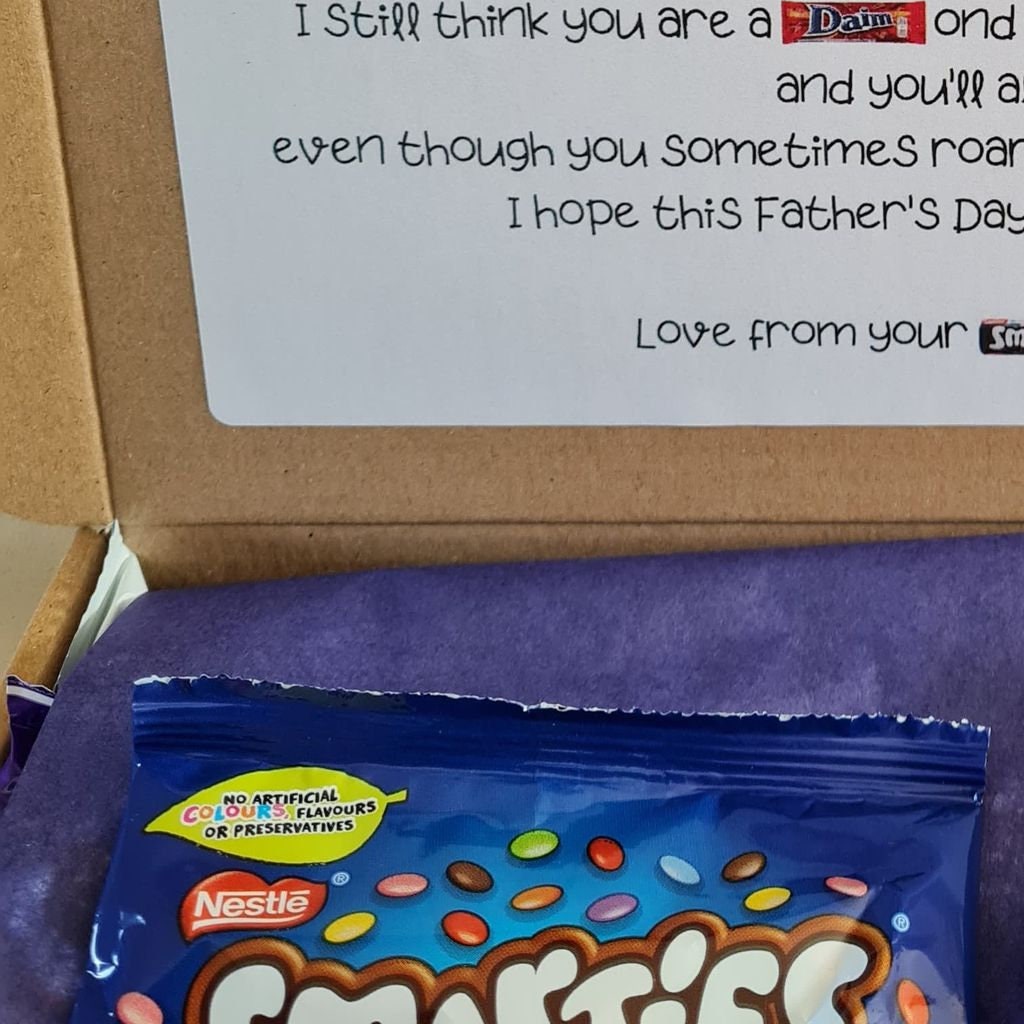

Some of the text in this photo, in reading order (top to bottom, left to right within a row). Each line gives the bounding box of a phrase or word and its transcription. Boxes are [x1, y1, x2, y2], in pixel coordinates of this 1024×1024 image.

[295, 3, 310, 37] I
[433, 1, 548, 39] think
[563, 7, 645, 43] you
[658, 7, 735, 39] are
[748, 7, 771, 38] a
[806, 4, 893, 35] Daim
[934, 4, 1016, 40] ond
[776, 69, 854, 105] and
[868, 68, 984, 109] you'll
[273, 135, 385, 165] even
[398, 131, 554, 172] though
[567, 137, 648, 171] you
[661, 132, 918, 168] sometimes
[508, 197, 522, 228] I
[533, 194, 639, 235] hope
[653, 195, 742, 230] this
[754, 194, 940, 232] Father's
[637, 318, 736, 349] Love
[749, 319, 856, 351] from
[869, 320, 968, 352] your
[183, 801, 376, 824] COLOURS, FLAVOURS
[224, 788, 338, 805] NO ARTIFICIAL
[205, 820, 354, 839] OR PRESERVATIVES
